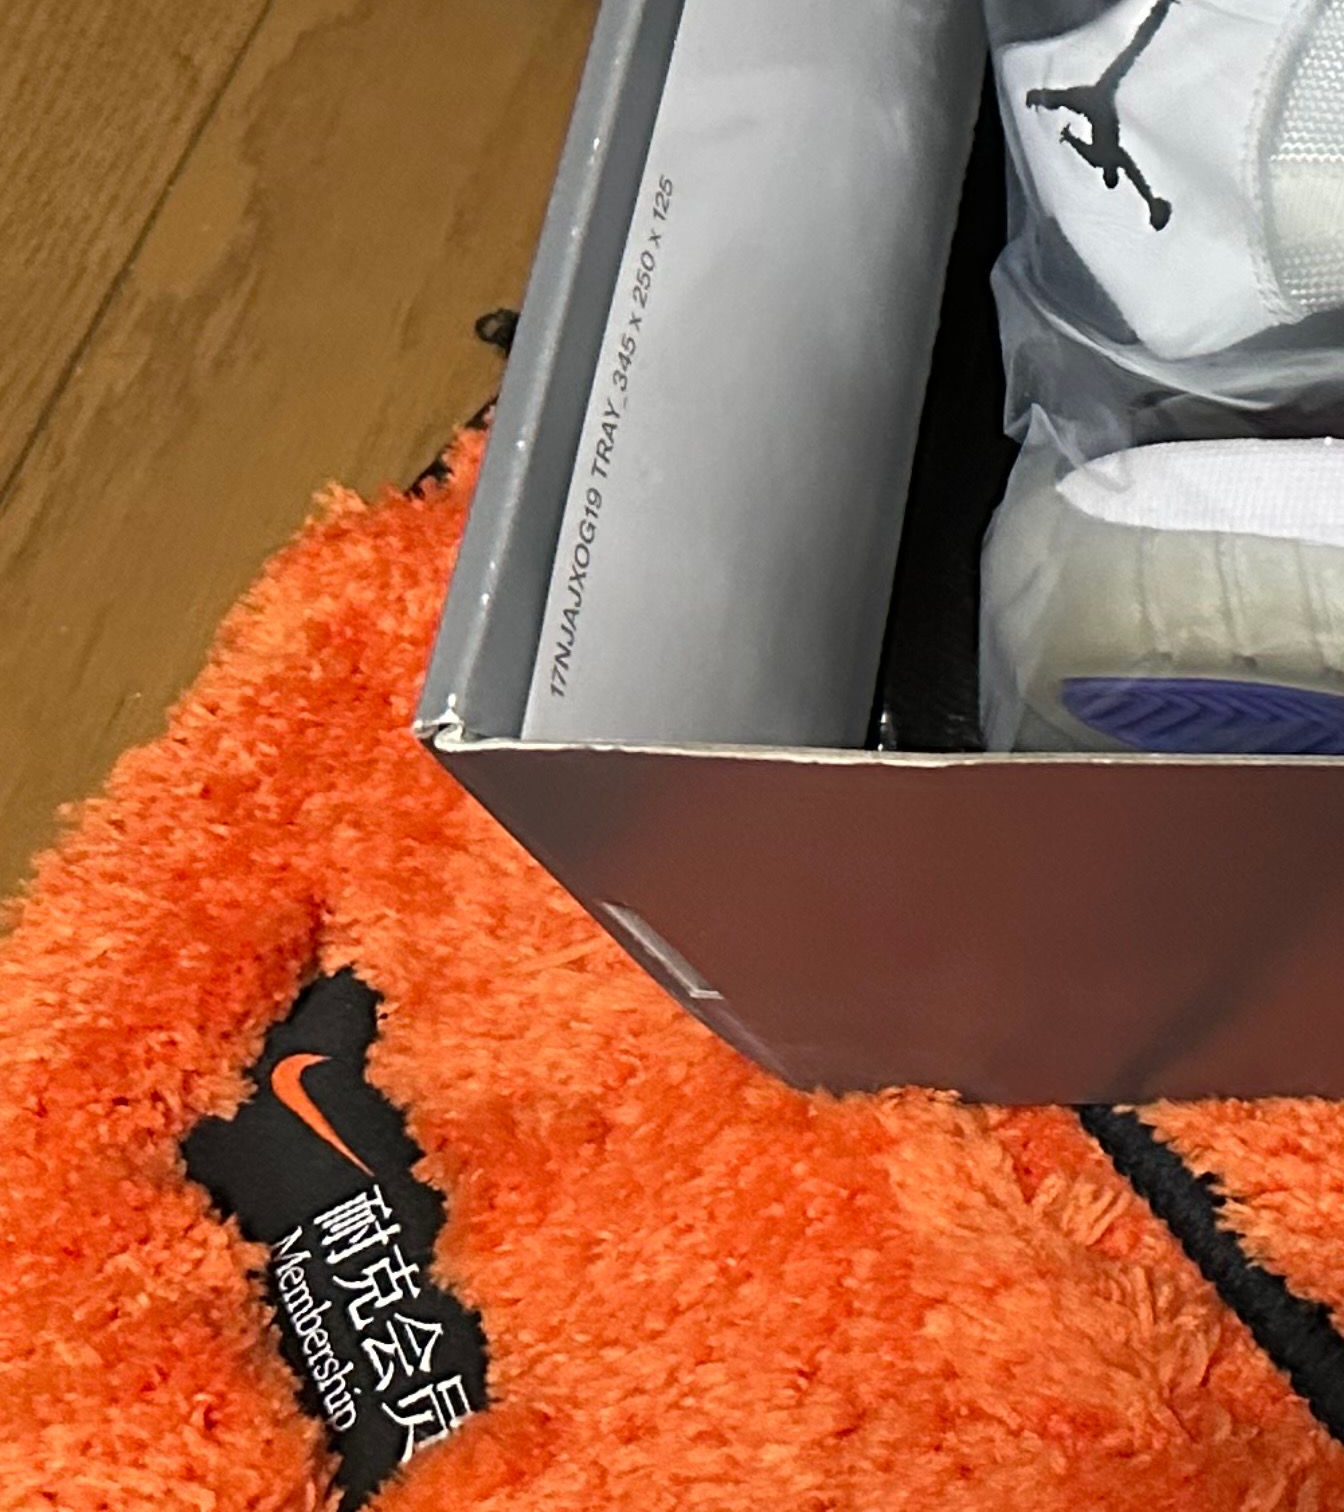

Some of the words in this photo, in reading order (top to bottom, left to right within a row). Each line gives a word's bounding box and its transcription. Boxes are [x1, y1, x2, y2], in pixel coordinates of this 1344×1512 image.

[631, 249, 656, 306] 250
[652, 173, 674, 221] 125
[270, 1224, 361, 1432] Membership
[313, 1182, 475, 1464] 耐克会员
